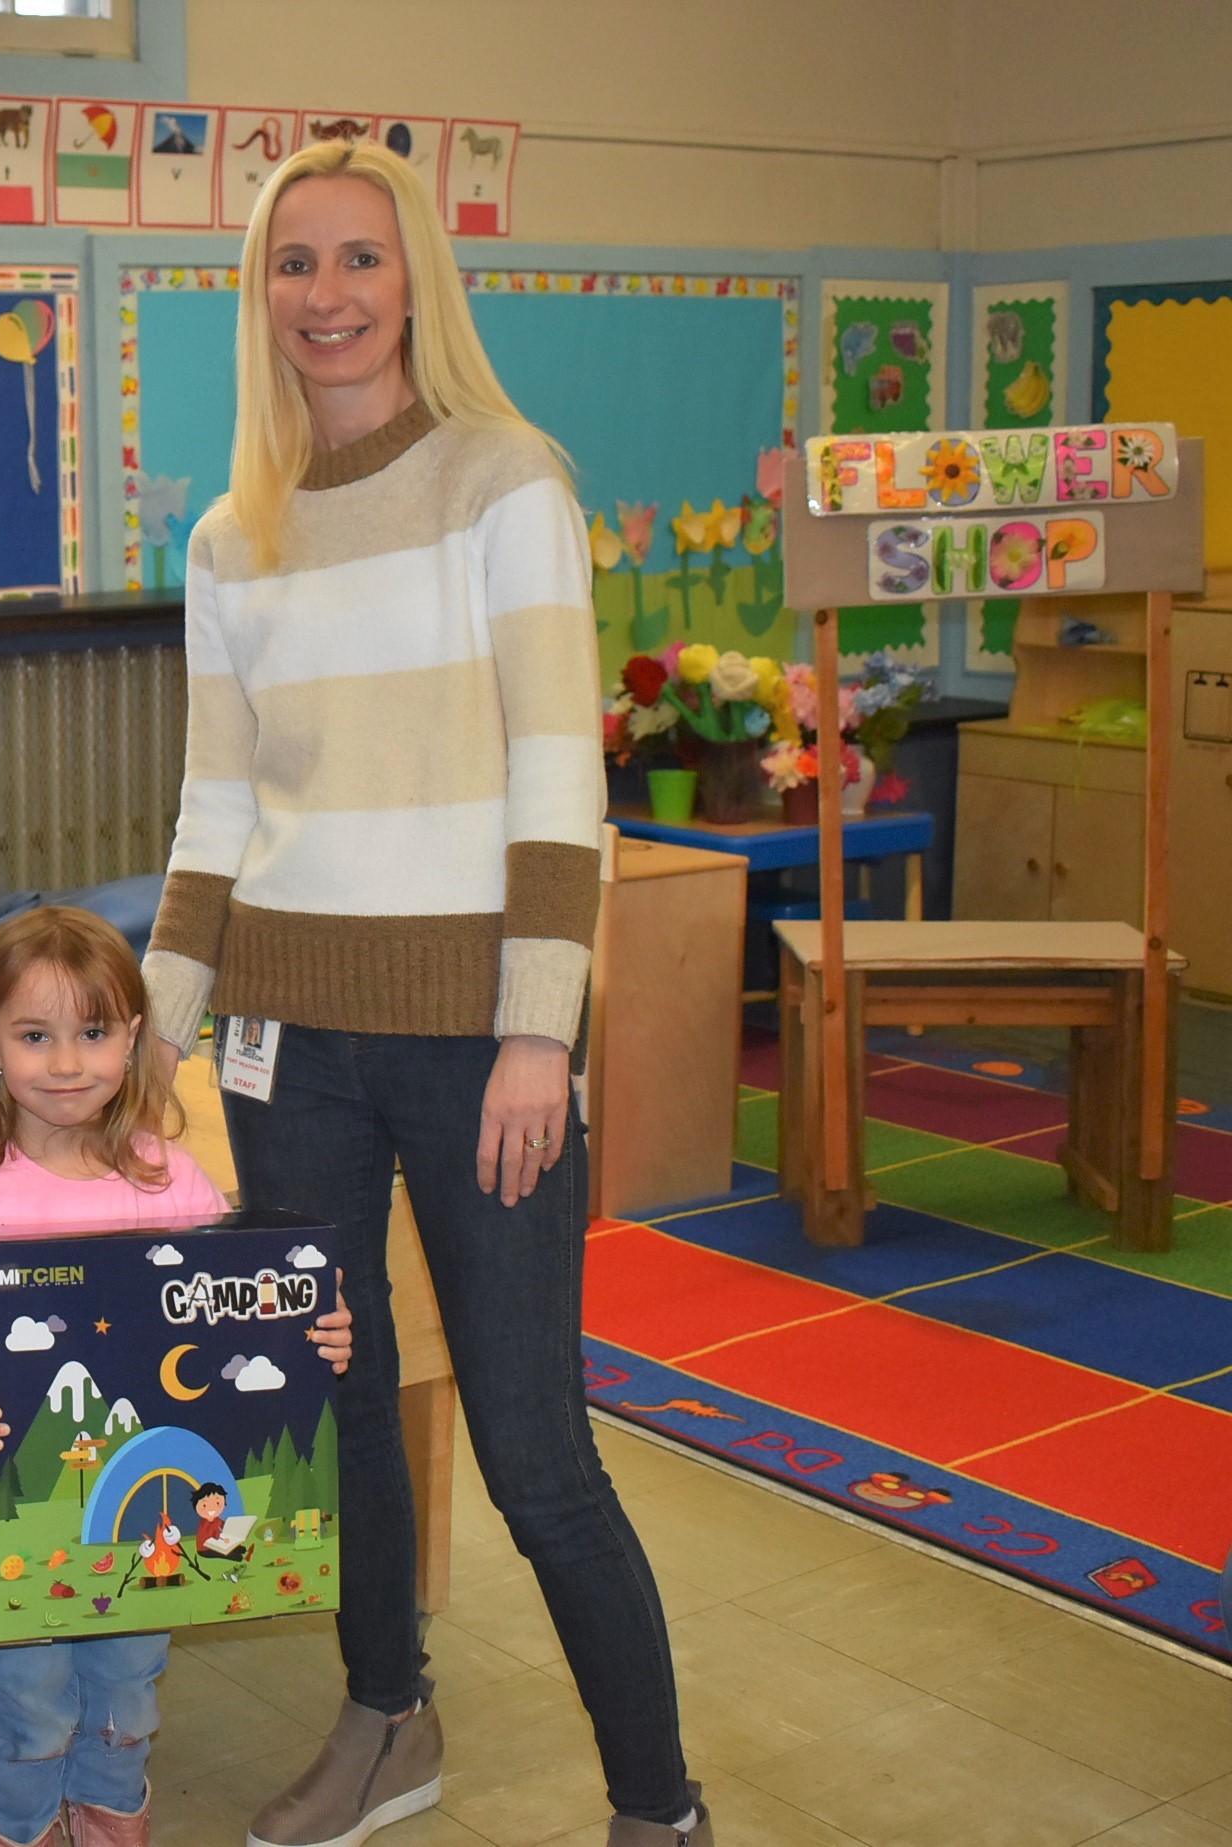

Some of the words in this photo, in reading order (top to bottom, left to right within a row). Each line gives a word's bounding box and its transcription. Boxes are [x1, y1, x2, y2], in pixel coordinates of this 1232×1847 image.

[820, 429, 1170, 512] FLOWER
[875, 518, 1098, 595] SHOP
[233, 1077, 257, 1090] STAFF
[164, 1271, 315, 1322] CAMPING
